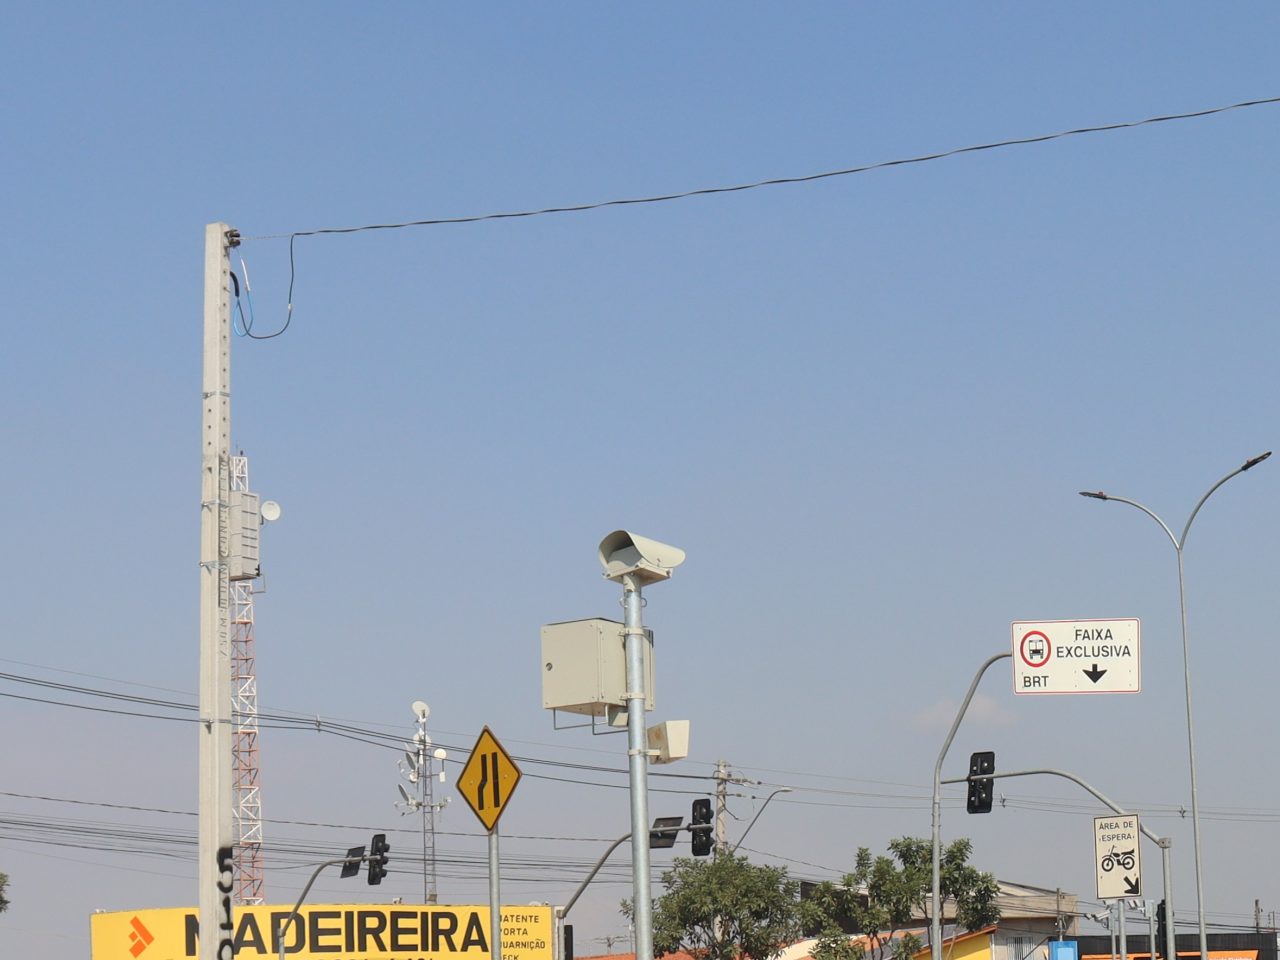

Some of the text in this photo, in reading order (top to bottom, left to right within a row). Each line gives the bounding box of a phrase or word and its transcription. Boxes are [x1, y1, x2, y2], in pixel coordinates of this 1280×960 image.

[1075, 628, 1113, 641] FAIXA
[1056, 645, 1131, 658] EXCLUSIVA
[1023, 675, 1049, 688] BRT
[1123, 821, 1134, 829] DE
[1101, 833, 1132, 842] ESPERA
[500, 914, 539, 923] ATENTE
[500, 927, 528, 936] ORTA
[501, 938, 546, 951] UARNIÇÃO
